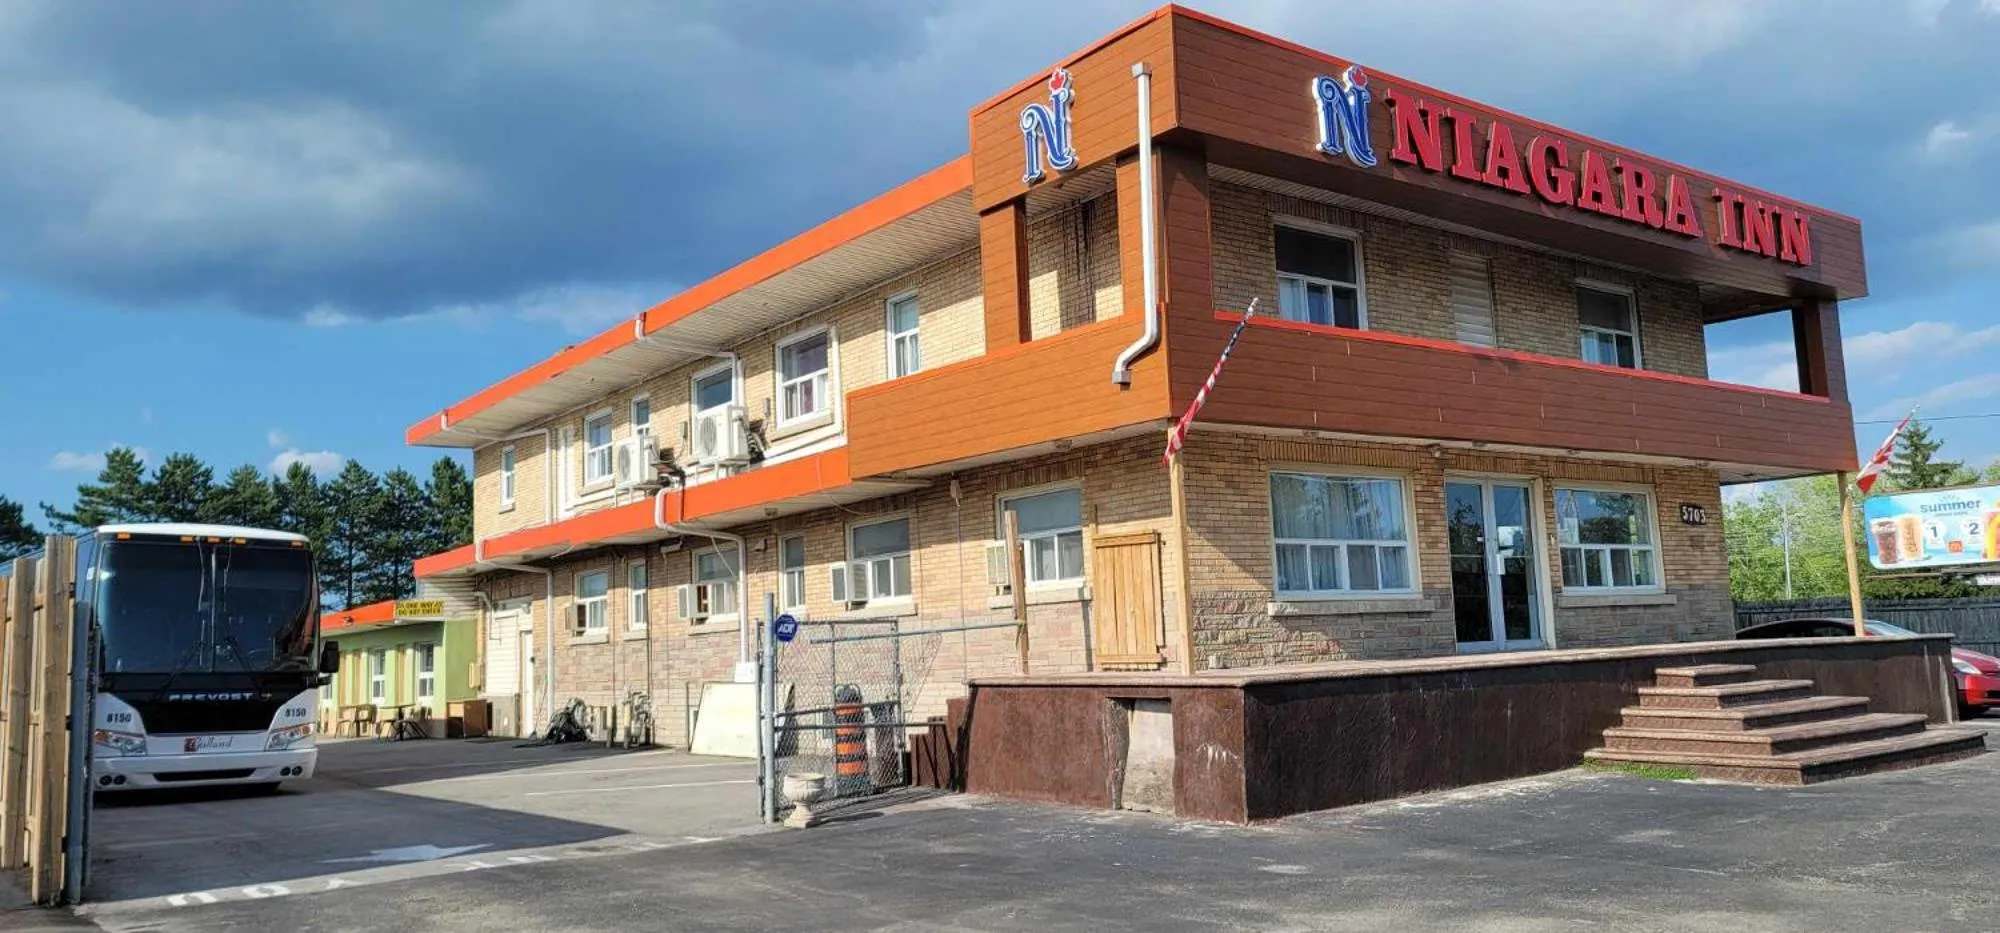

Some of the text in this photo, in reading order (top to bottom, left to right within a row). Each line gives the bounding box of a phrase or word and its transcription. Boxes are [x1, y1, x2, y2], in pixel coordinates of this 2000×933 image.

[1386, 88, 1812, 265] NIAGARA INN
[1920, 500, 1981, 513] summer
[1682, 505, 1706, 523] 5703
[778, 623, 796, 634] ADT
[168, 692, 255, 701] PREVOST
[106, 712, 132, 723] 8150
[284, 707, 307, 718] 8150
